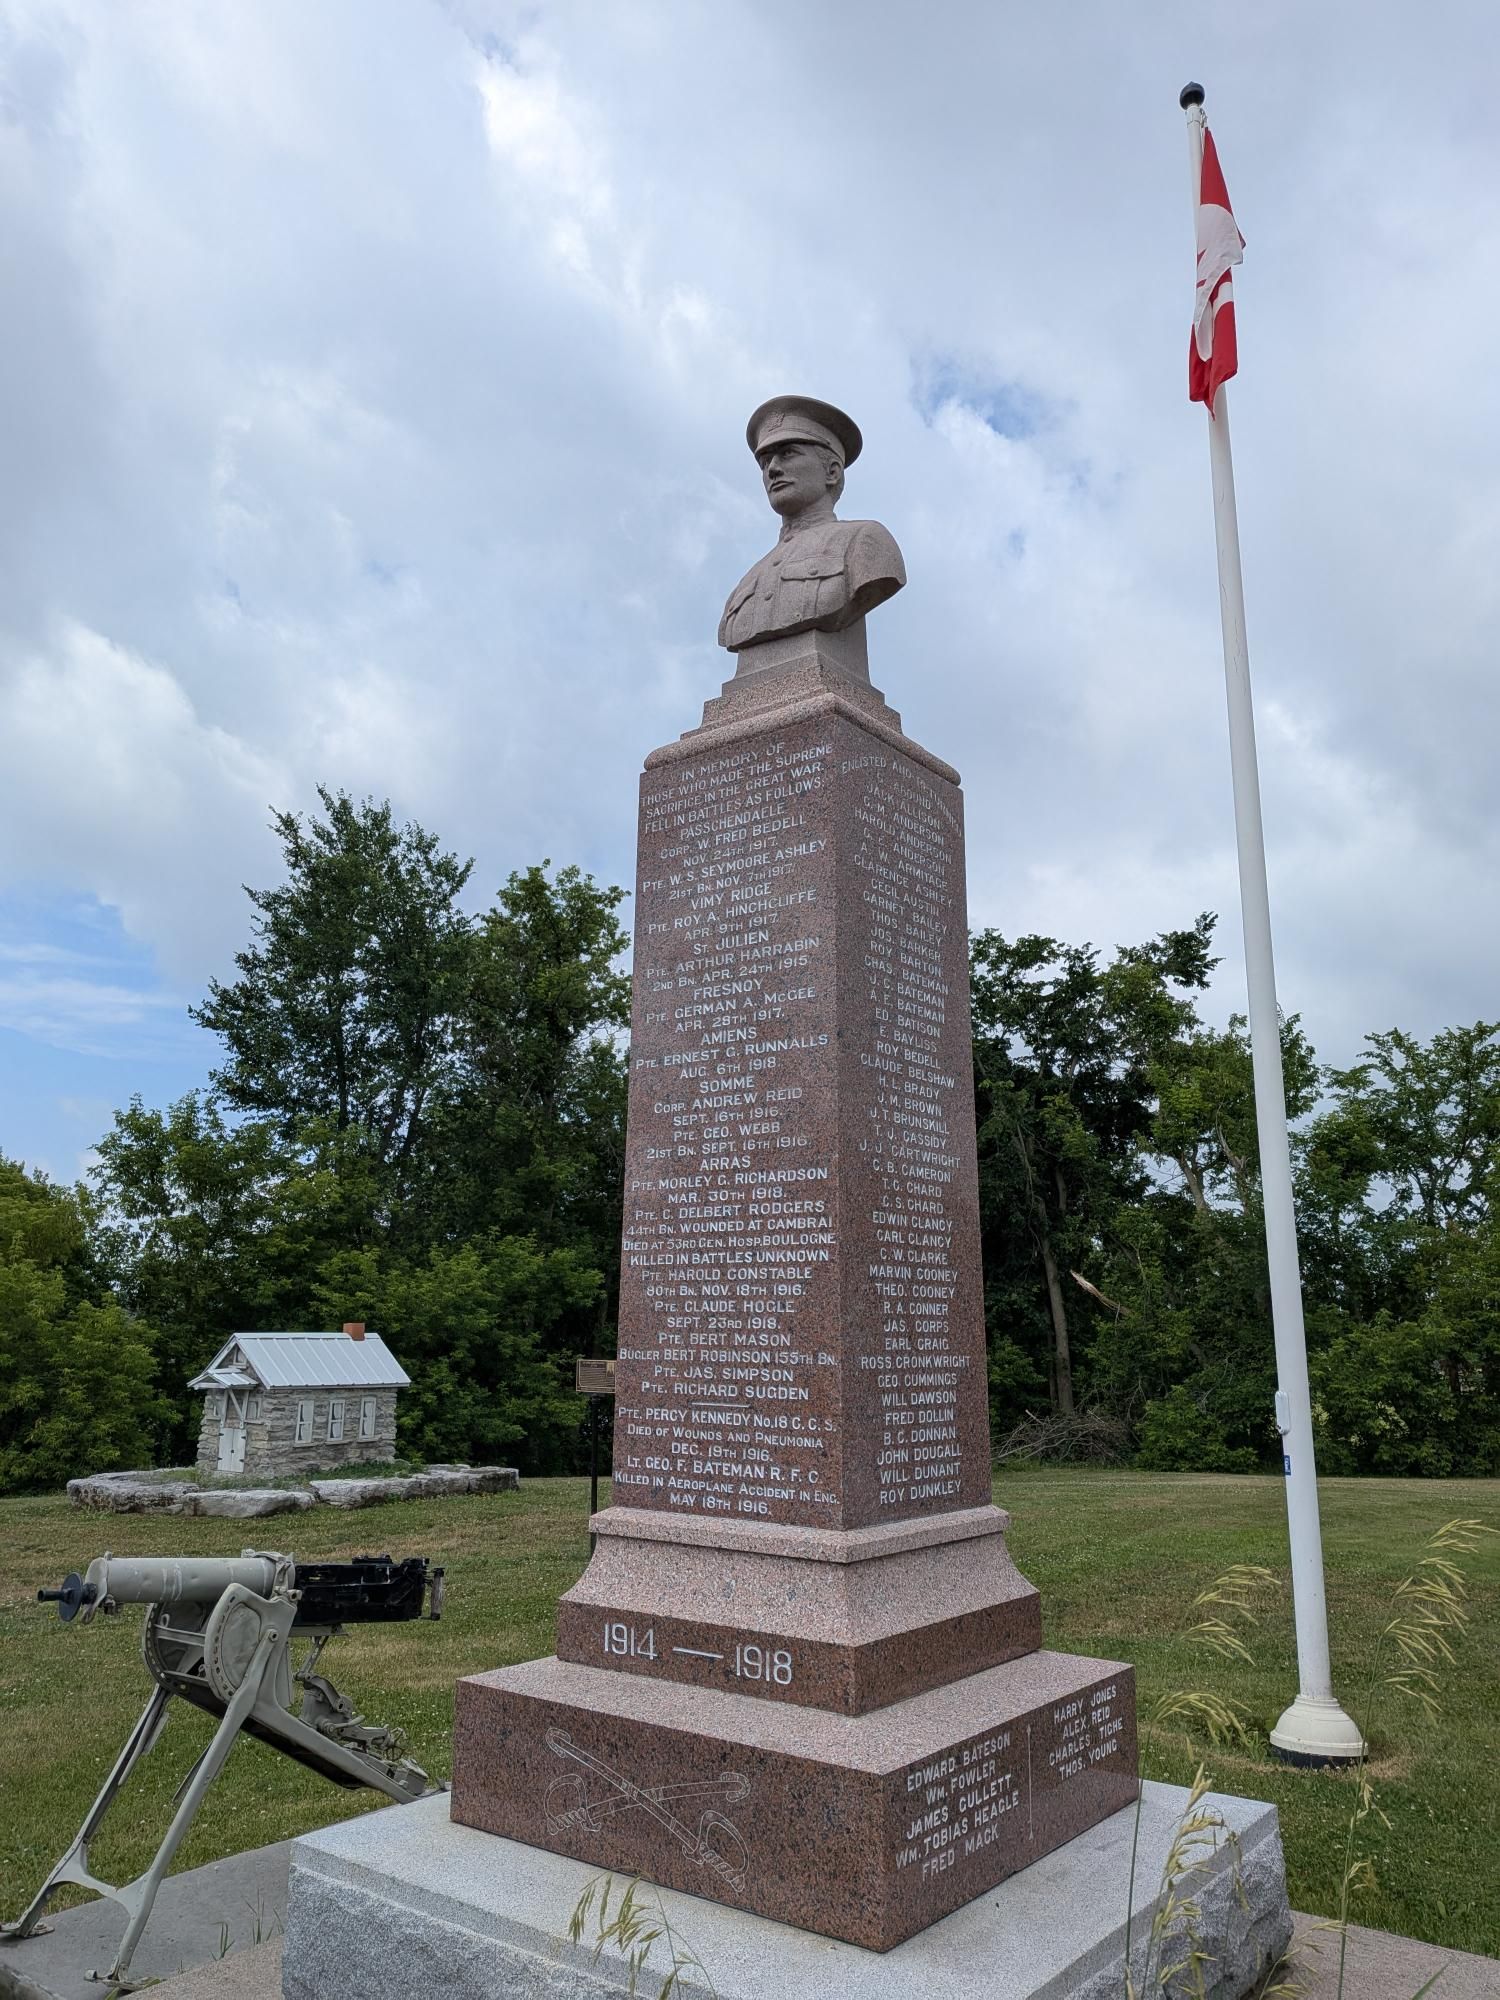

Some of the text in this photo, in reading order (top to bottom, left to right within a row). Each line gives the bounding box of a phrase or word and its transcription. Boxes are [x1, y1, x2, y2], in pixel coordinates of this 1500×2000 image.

[641, 742, 832, 807] THOSE WHO MADE THE SUPREME
[681, 767, 694, 781] IN
[700, 748, 759, 776] MEMORY
[893, 761, 912, 778] AND
[646, 795, 700, 819] SACRIFICE
[704, 790, 715, 803] IN
[718, 783, 740, 799] THE
[745, 771, 784, 792] GREAT
[644, 817, 669, 834] FELL
[674, 813, 685, 826] IN
[688, 797, 741, 822] BATTLES
[745, 792, 762, 807] AS
[680, 802, 784, 840] PASSCHENDAELE
[853, 853, 952, 909] CLARENCE ASHLEY
[690, 881, 771, 910] VIMY RIDGE
[863, 889, 947, 936] GARNET BAILEY
[715, 929, 768, 951] JULIEN
[905, 923, 942, 948] BAILEY
[675, 952, 734, 973] ARTHUR
[740, 936, 819, 962] HARRABIN
[870, 940, 941, 978] ROY BARTON
[899, 936, 941, 963] BARKER
[693, 978, 763, 1000] FRESNOY
[902, 968, 948, 995] BATEMAN
[700, 1026, 757, 1046] AMIENS
[663, 1048, 720, 1066] ERNEST
[745, 1034, 828, 1055] RUNNALLS
[876, 1040, 940, 1070] ROY BEDELL
[860, 1052, 955, 1089] CLAUDE BELSHAW
[699, 1075, 755, 1094] SOMME
[692, 1092, 757, 1110] ANDREW
[765, 1087, 802, 1102] REID
[699, 1154, 751, 1171] ARRAS
[658, 1175, 712, 1190] MORLEY
[734, 1167, 827, 1185] RICHARDSON
[679, 1220, 744, 1233] WOUNDED
[747, 1219, 763, 1231] AT
[766, 1216, 832, 1230] CAMBRAI
[872, 1210, 953, 1232] EDWIN CLANCY
[876, 1228, 951, 1248] CARL CLANCY
[630, 1250, 829, 1265] KILLED IN BATTLES UNKNOWN
[869, 1264, 958, 1282] MARVIN COONEY
[912, 1285, 955, 1299] COONEY
[663, 1349, 696, 1361] BERT
[700, 1350, 770, 1363] ROBINSON
[884, 1337, 911, 1350] EARL
[861, 1355, 971, 1369] ROSS CRONKWRIGHT
[673, 1382, 738, 1397] RICHARD
[744, 1385, 809, 1400] SUGDEN
[910, 1390, 956, 1405] DAWSON
[884, 1407, 954, 1426] FRED DOLLIN
[727, 1432, 750, 1443] AND
[911, 1425, 956, 1442] DONNAN
[876, 1442, 962, 1465] JOHN DOUGALL
[914, 1461, 960, 1480] DUNANT
[614, 1470, 649, 1485] KILLED
[653, 1476, 664, 1487] IN
[667, 1475, 733, 1494] AEROPLANE
[738, 1482, 795, 1500] ACCIDENT
[799, 1491, 810, 1501] IN
[880, 1479, 961, 1505] ROY DUNKLEY
[670, 1492, 696, 1507] MAY
[603, 1622, 658, 1661] 1914
[735, 1643, 793, 1686] 1918
[1053, 1683, 1116, 1725] HARRY JONES
[1091, 1703, 1111, 1726] REID
[906, 1730, 1010, 1793] EDWARD BATESON
[1048, 1732, 1090, 1767] CHARLES
[1088, 1738, 1117, 1766] YOUNG
[950, 1757, 996, 1795] FOWLER
[906, 1804, 948, 1841] JAMES
[923, 1816, 968, 1856] TOBIAS
[974, 1789, 1019, 1828] HEAGLE
[921, 1821, 999, 1882] FRED MACK
